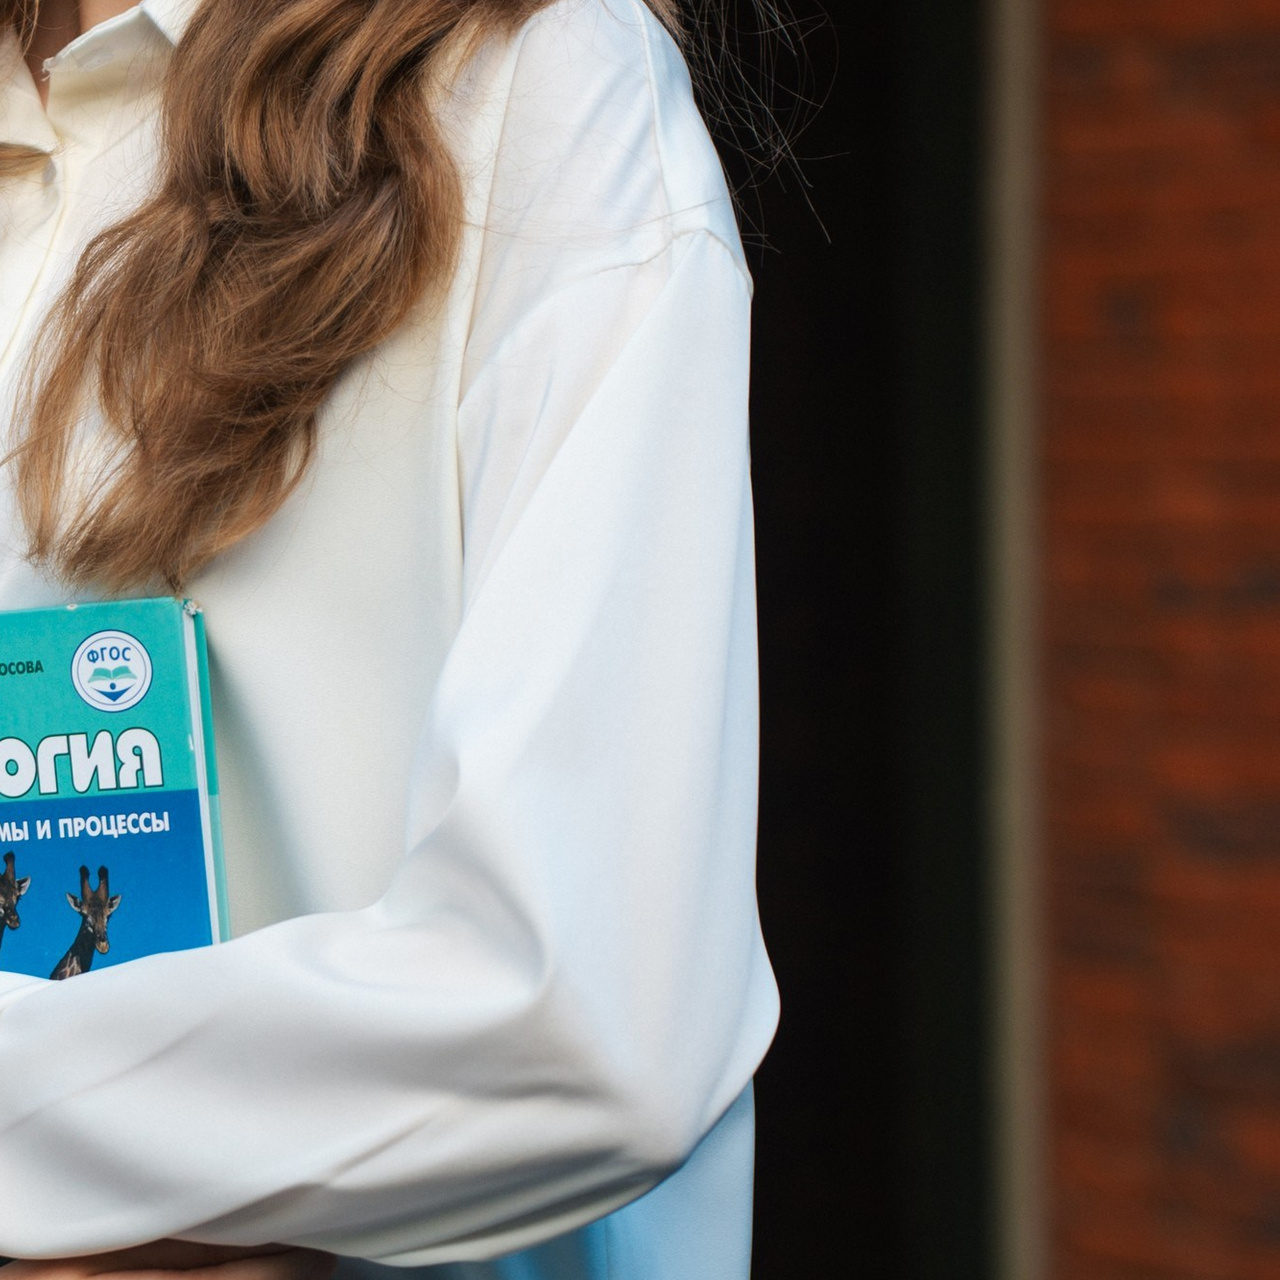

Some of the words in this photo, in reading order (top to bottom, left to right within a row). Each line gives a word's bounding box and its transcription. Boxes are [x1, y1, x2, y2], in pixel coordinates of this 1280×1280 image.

[87, 646, 131, 663] ФГОС
[36, 819, 52, 839] И
[58, 811, 169, 838] ПРОЦЕССЫ
